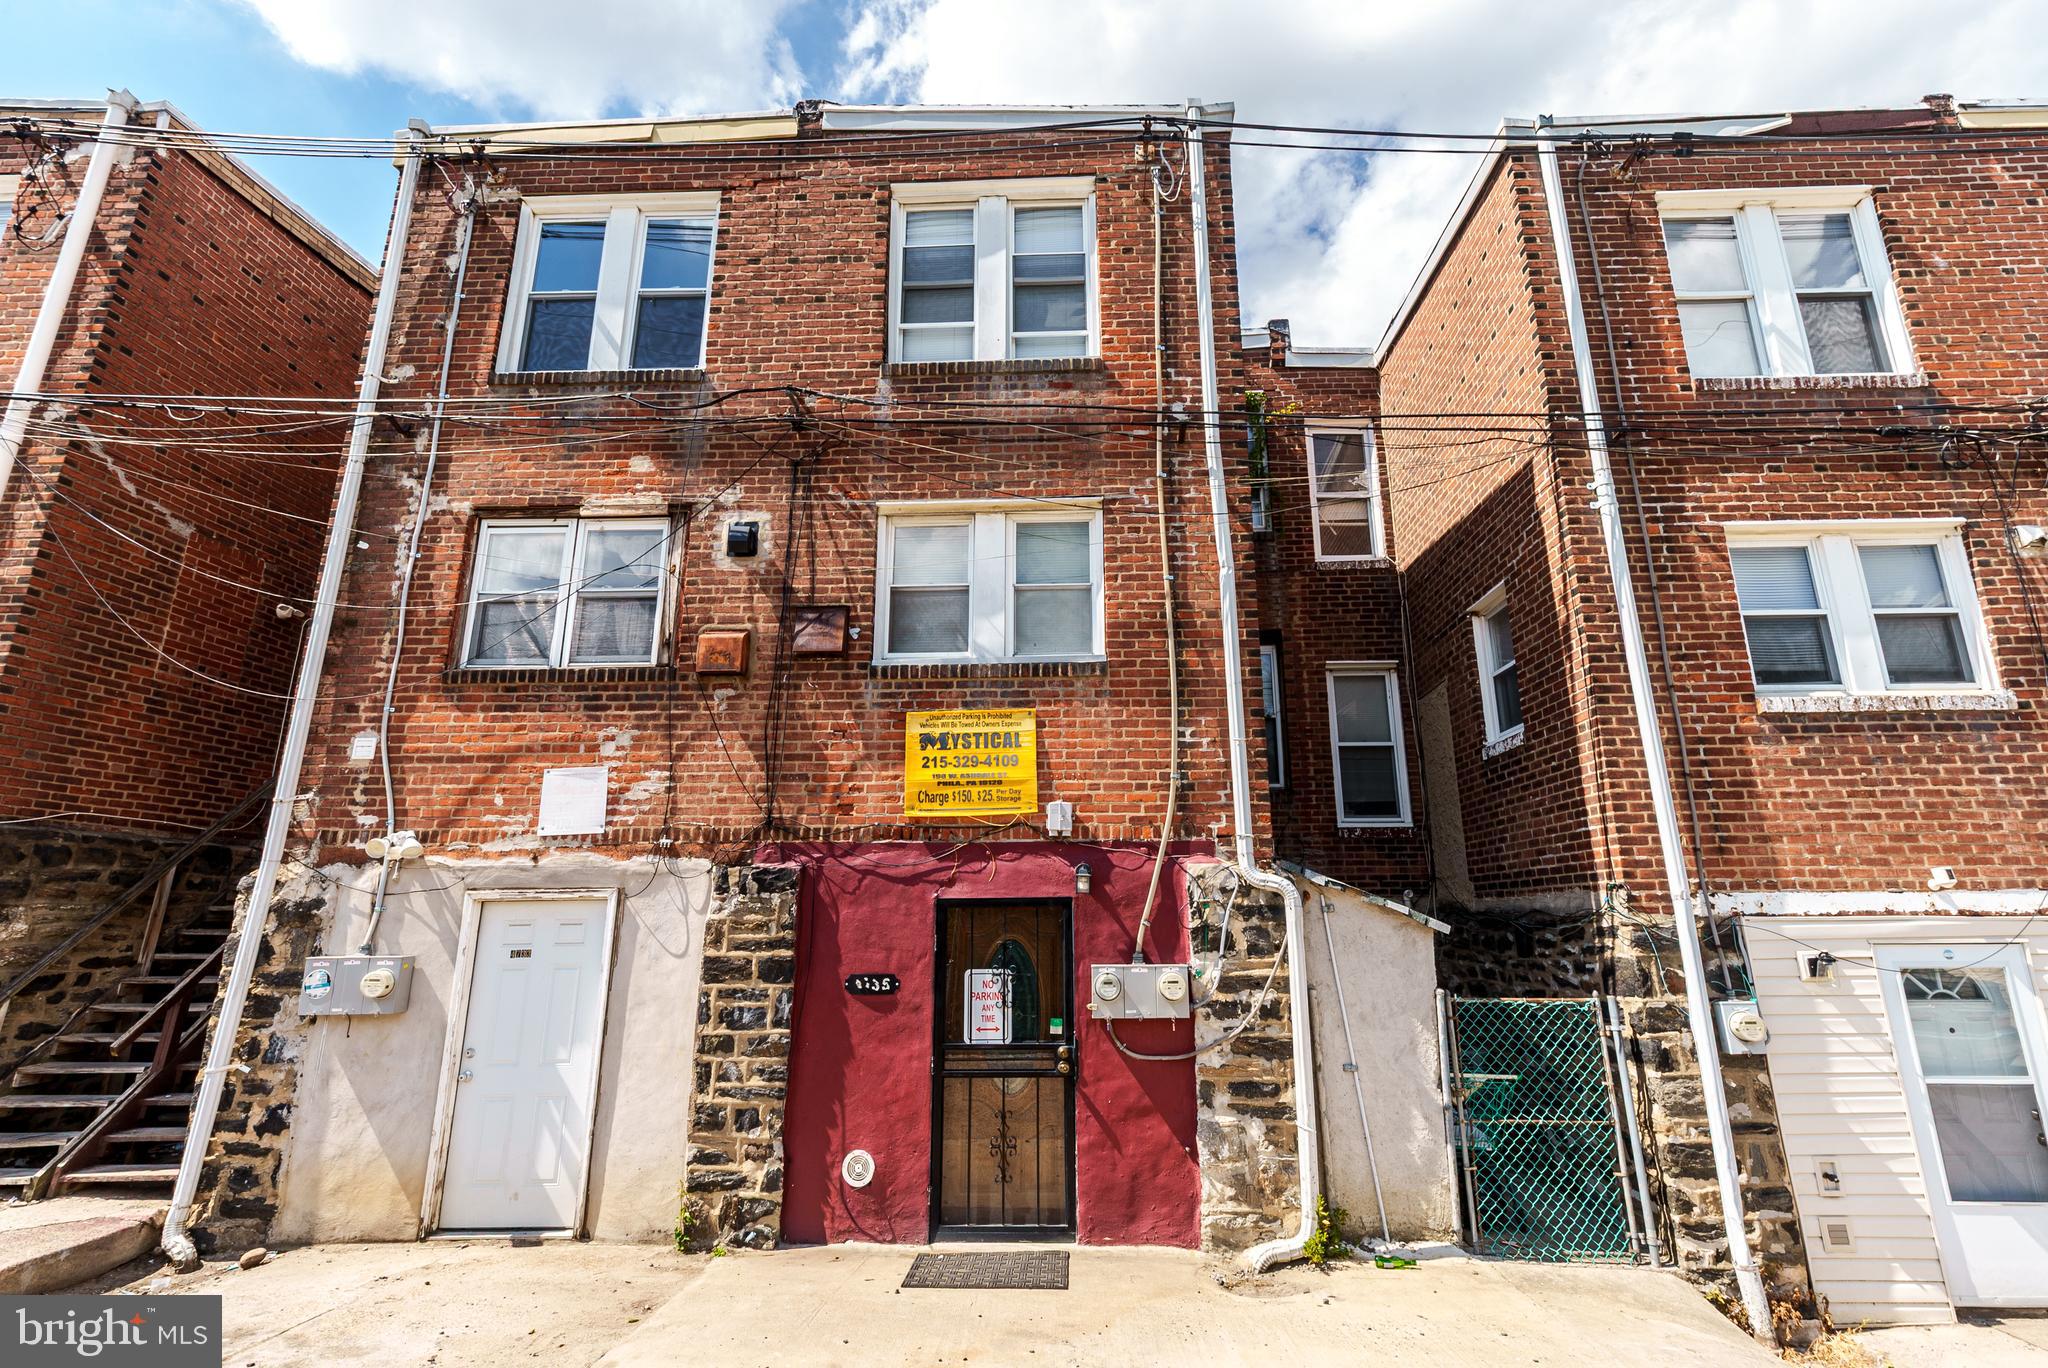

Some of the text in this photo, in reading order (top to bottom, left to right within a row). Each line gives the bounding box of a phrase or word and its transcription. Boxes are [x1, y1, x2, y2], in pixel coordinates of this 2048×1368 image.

[929, 713, 961, 721] Unauthorized
[962, 712, 981, 721] Parking
[919, 721, 940, 729] Vehicles
[919, 731, 1022, 751] MYSTICAL
[921, 754, 1019, 768] 215-329-4109
[918, 790, 949, 806] Charge
[996, 795, 1022, 803] Storage
[982, 979, 994, 989] NO
[981, 1004, 995, 1012] ANY
[981, 1014, 996, 1023] TIME
